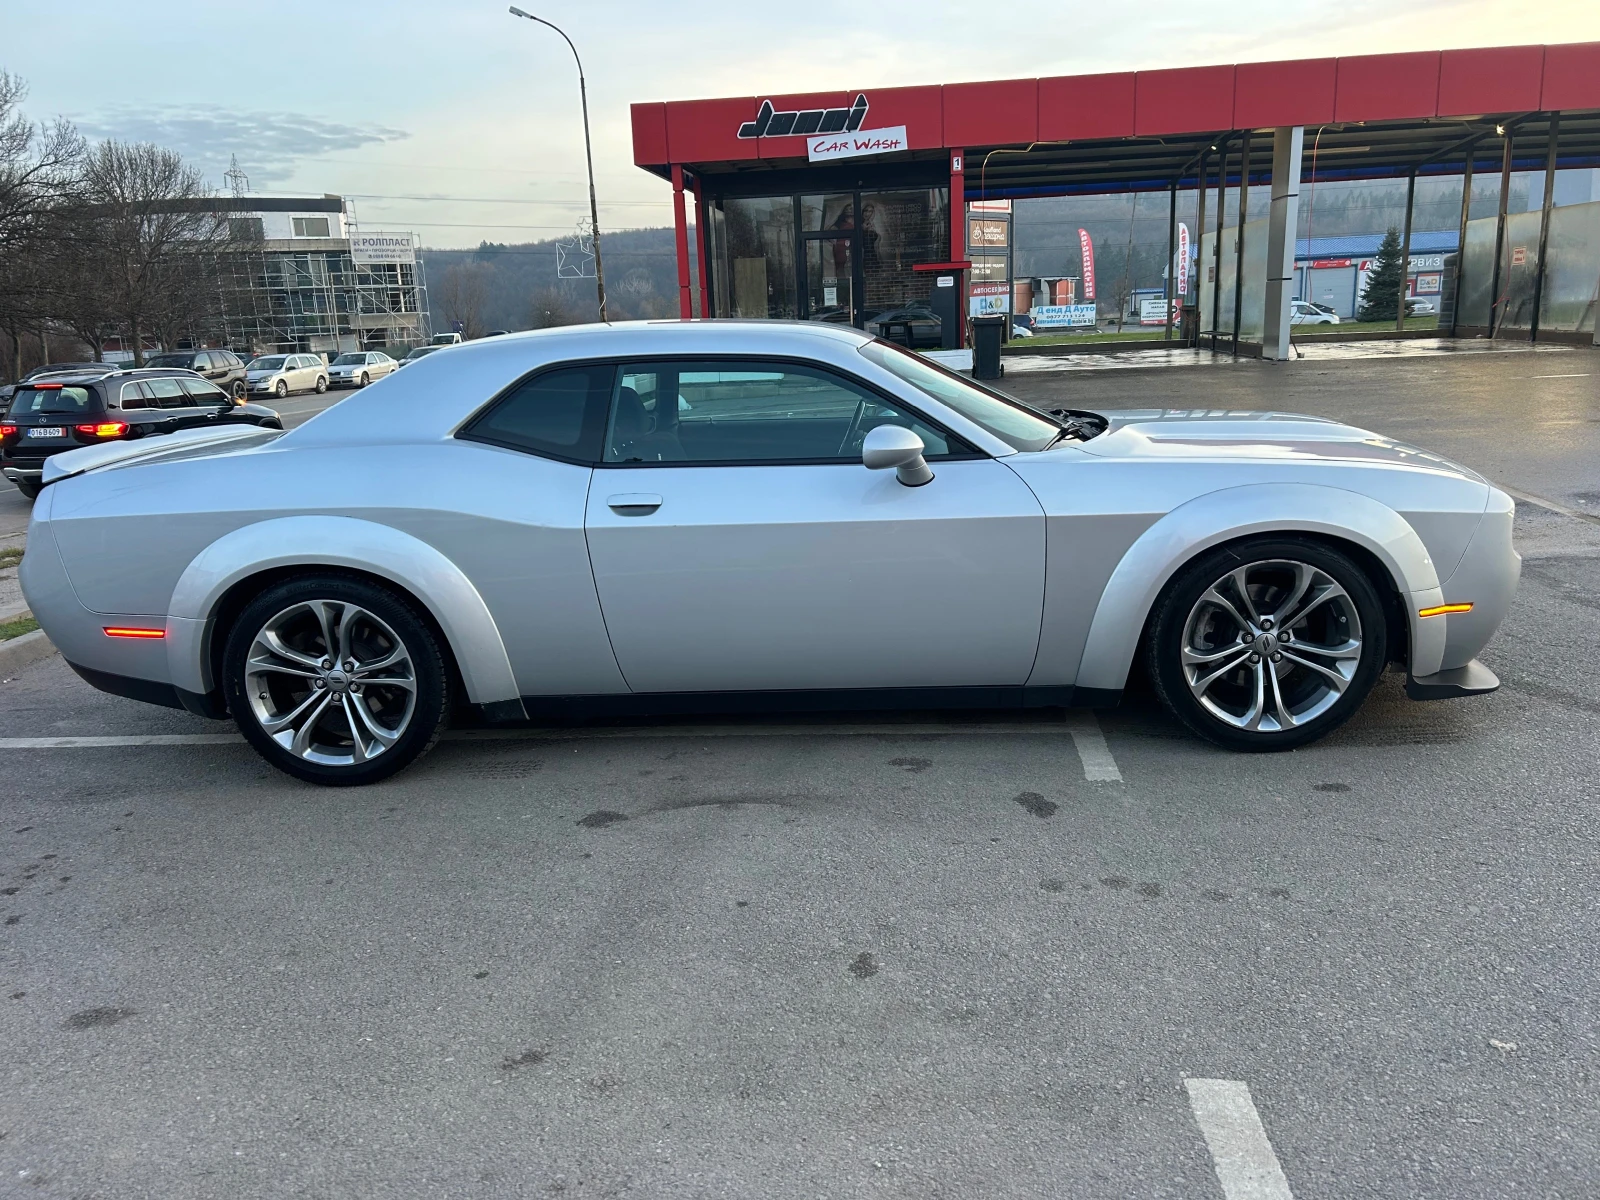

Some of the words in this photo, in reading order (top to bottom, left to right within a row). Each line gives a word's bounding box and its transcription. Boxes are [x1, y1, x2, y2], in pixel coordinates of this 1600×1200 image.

[813, 141, 849, 153] CAR
[853, 138, 901, 150] WASH
[955, 157, 960, 166] 1
[362, 238, 410, 246] РОЛПЛАСТ
[1064, 305, 1071, 314] Д
[1073, 305, 1095, 313] Ауто
